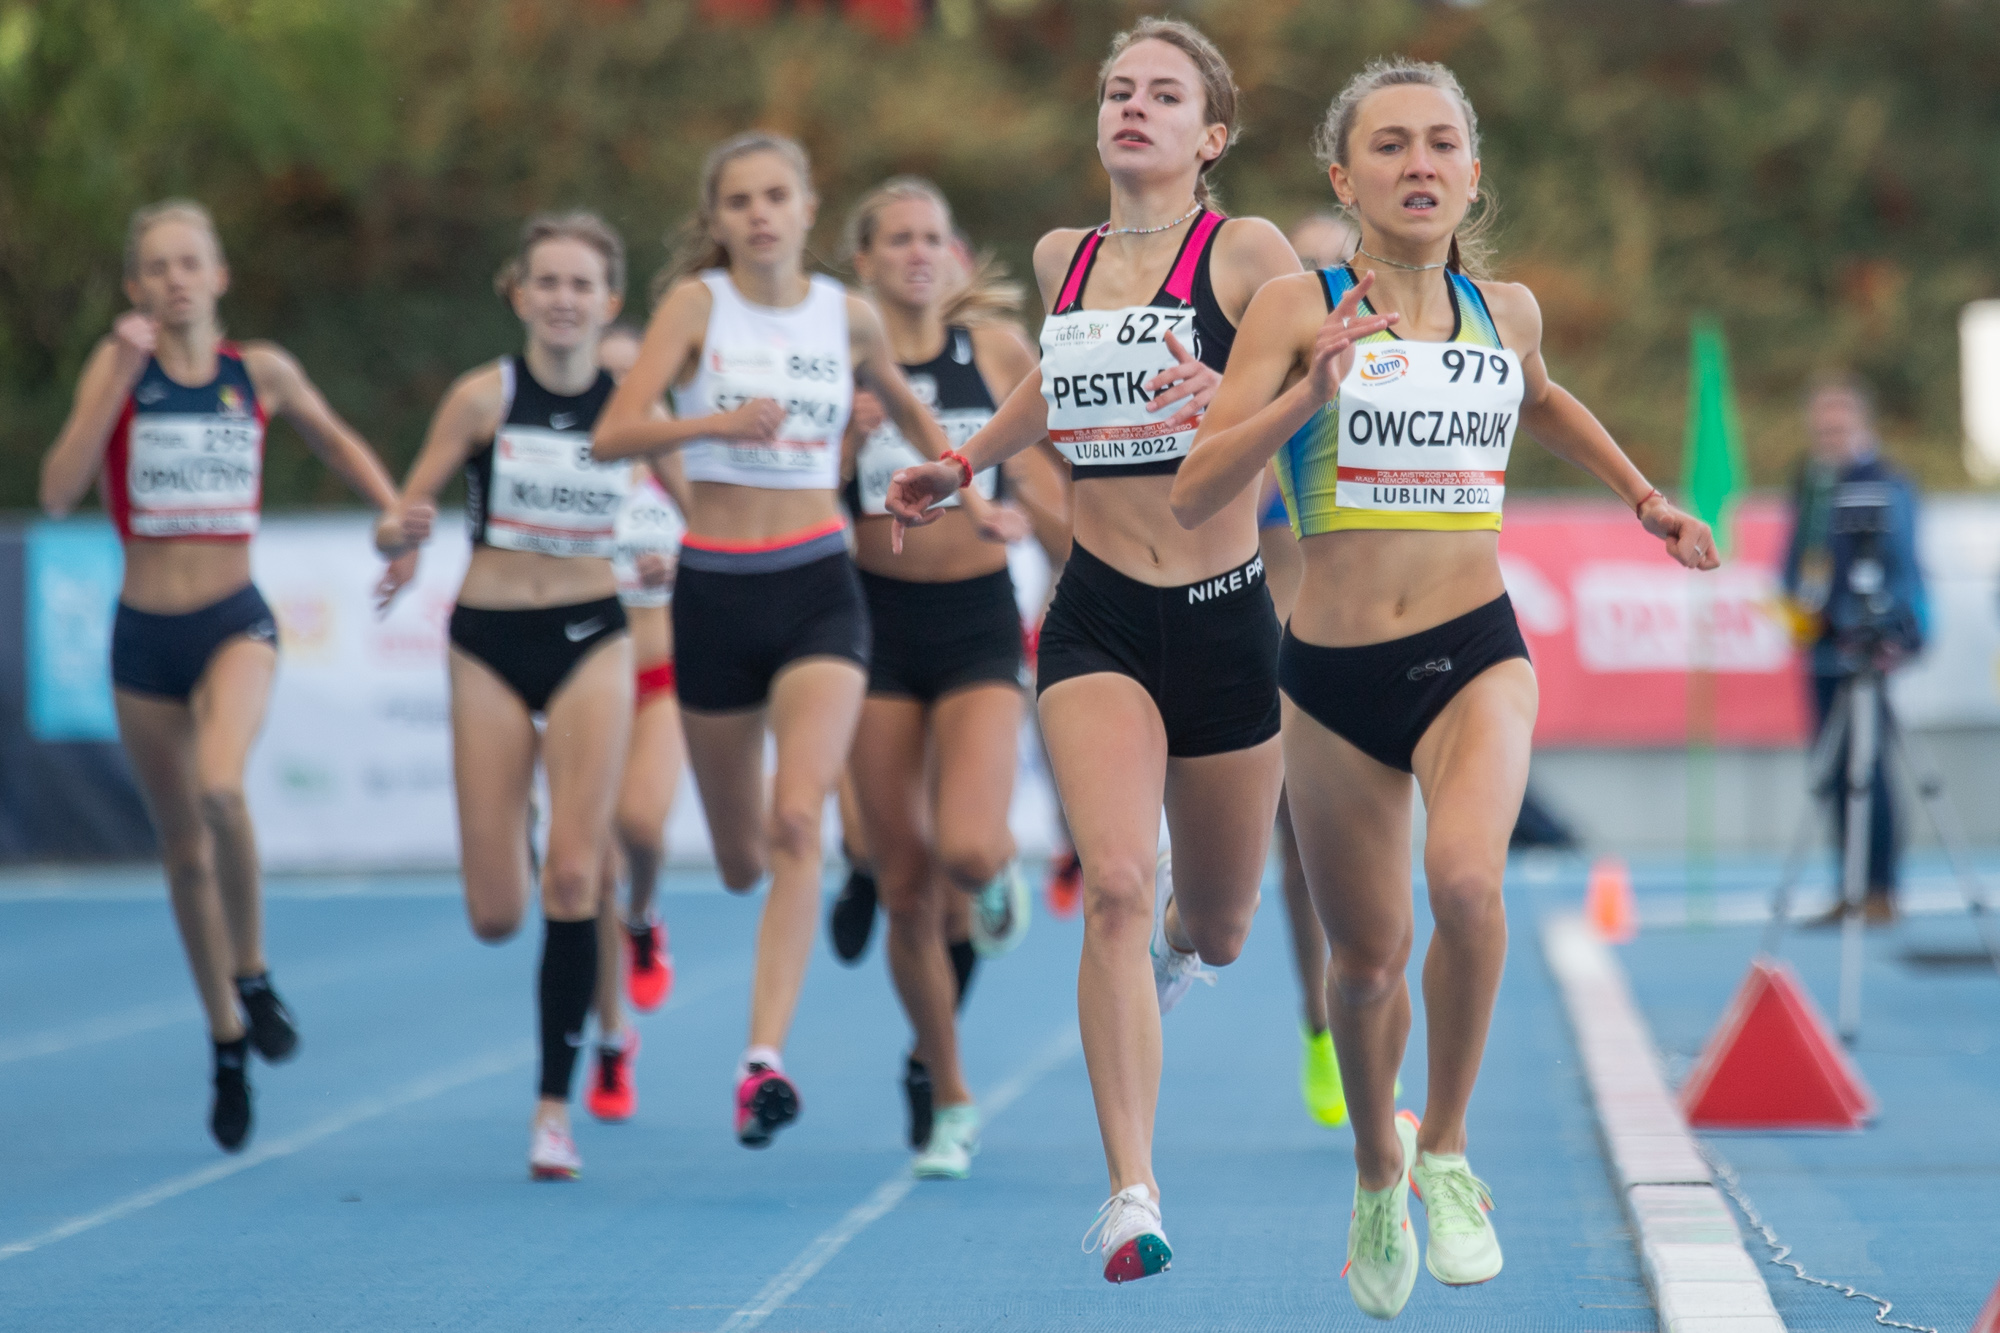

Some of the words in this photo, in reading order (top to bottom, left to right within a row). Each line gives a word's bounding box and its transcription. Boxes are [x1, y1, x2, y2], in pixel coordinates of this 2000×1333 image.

[1116, 313, 1185, 345] 627
[1369, 359, 1400, 376] LOTTO
[1442, 349, 1509, 386] 979
[1348, 409, 1512, 448] OWCZARUK
[1075, 442, 1126, 459] LUBLIN
[1130, 436, 1178, 456] 2022
[1373, 487, 1445, 504] LUBLIN
[1453, 487, 1490, 505] 2022
[1188, 570, 1243, 605] NIKE
[1245, 555, 1264, 585] PR
